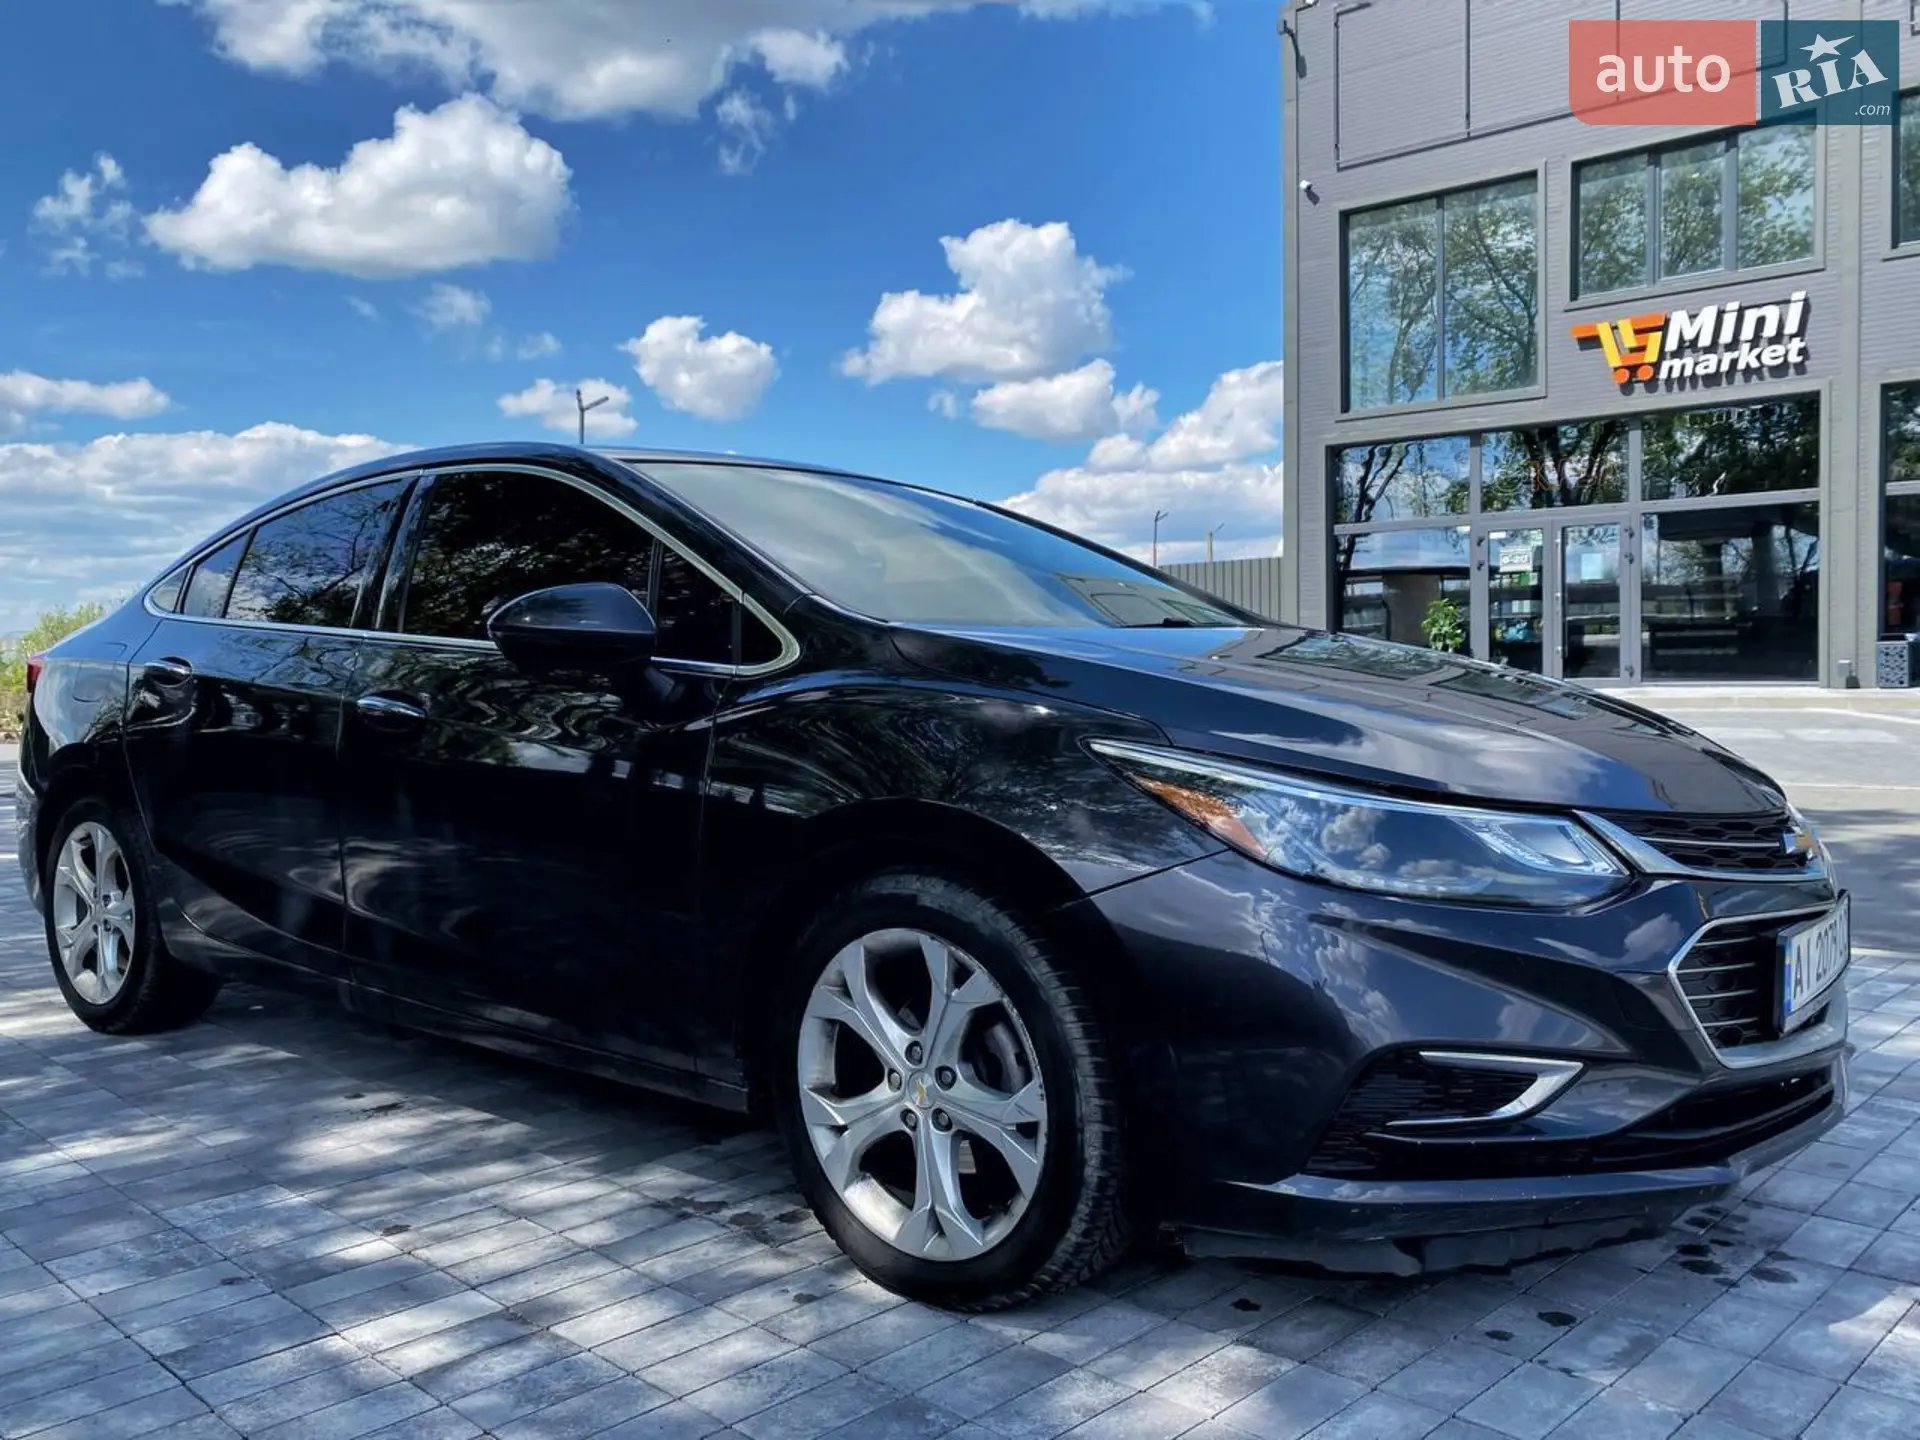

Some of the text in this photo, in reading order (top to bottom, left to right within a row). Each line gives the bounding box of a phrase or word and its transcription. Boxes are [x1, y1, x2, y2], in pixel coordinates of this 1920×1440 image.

[1664, 290, 1807, 352] Mini
[1659, 337, 1806, 380] market
[1793, 938, 1811, 999] AI
